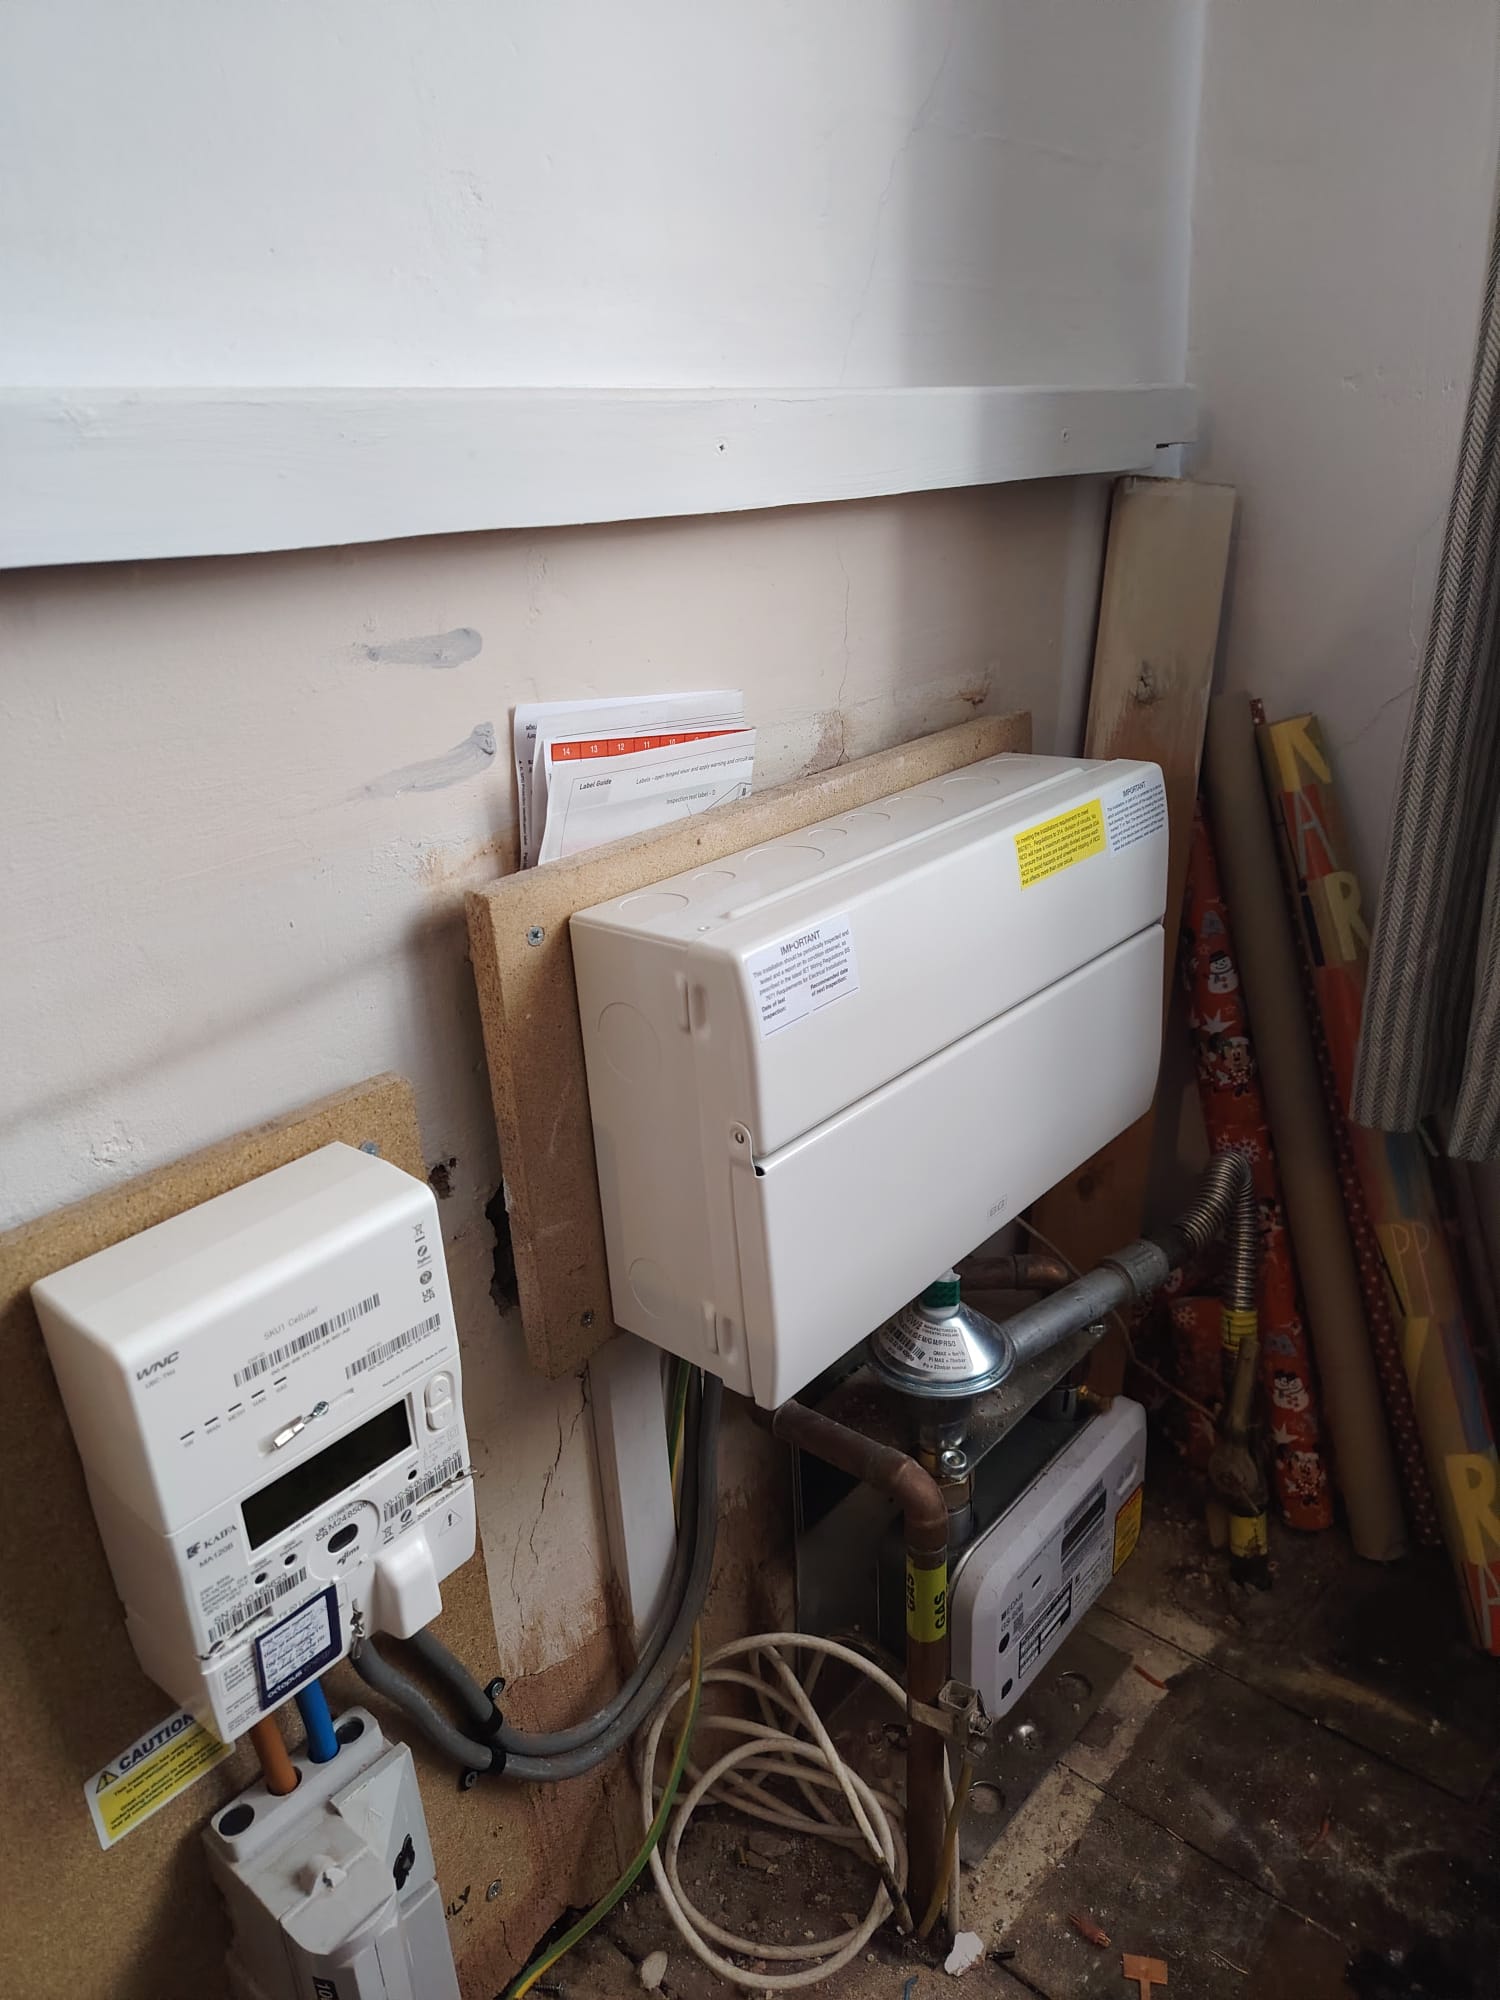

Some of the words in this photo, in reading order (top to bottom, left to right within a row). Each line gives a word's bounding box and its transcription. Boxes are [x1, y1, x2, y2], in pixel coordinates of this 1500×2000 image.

[563, 747, 570, 756] 14
[591, 745, 598, 753] 13
[618, 743, 624, 751] 12
[580, 782, 595, 790] Label
[780, 930, 820, 955] IMPORTANT
[840, 968, 848, 977] date
[761, 1003, 772, 1013] Date
[288, 1306, 318, 1327] Cellular
[136, 1351, 180, 1381] WNC
[203, 1525, 237, 1549] KAIFA
[934, 1590, 945, 1628] GAS
[268, 1671, 303, 1698] octopus
[119, 1714, 195, 1770] CAUTION
